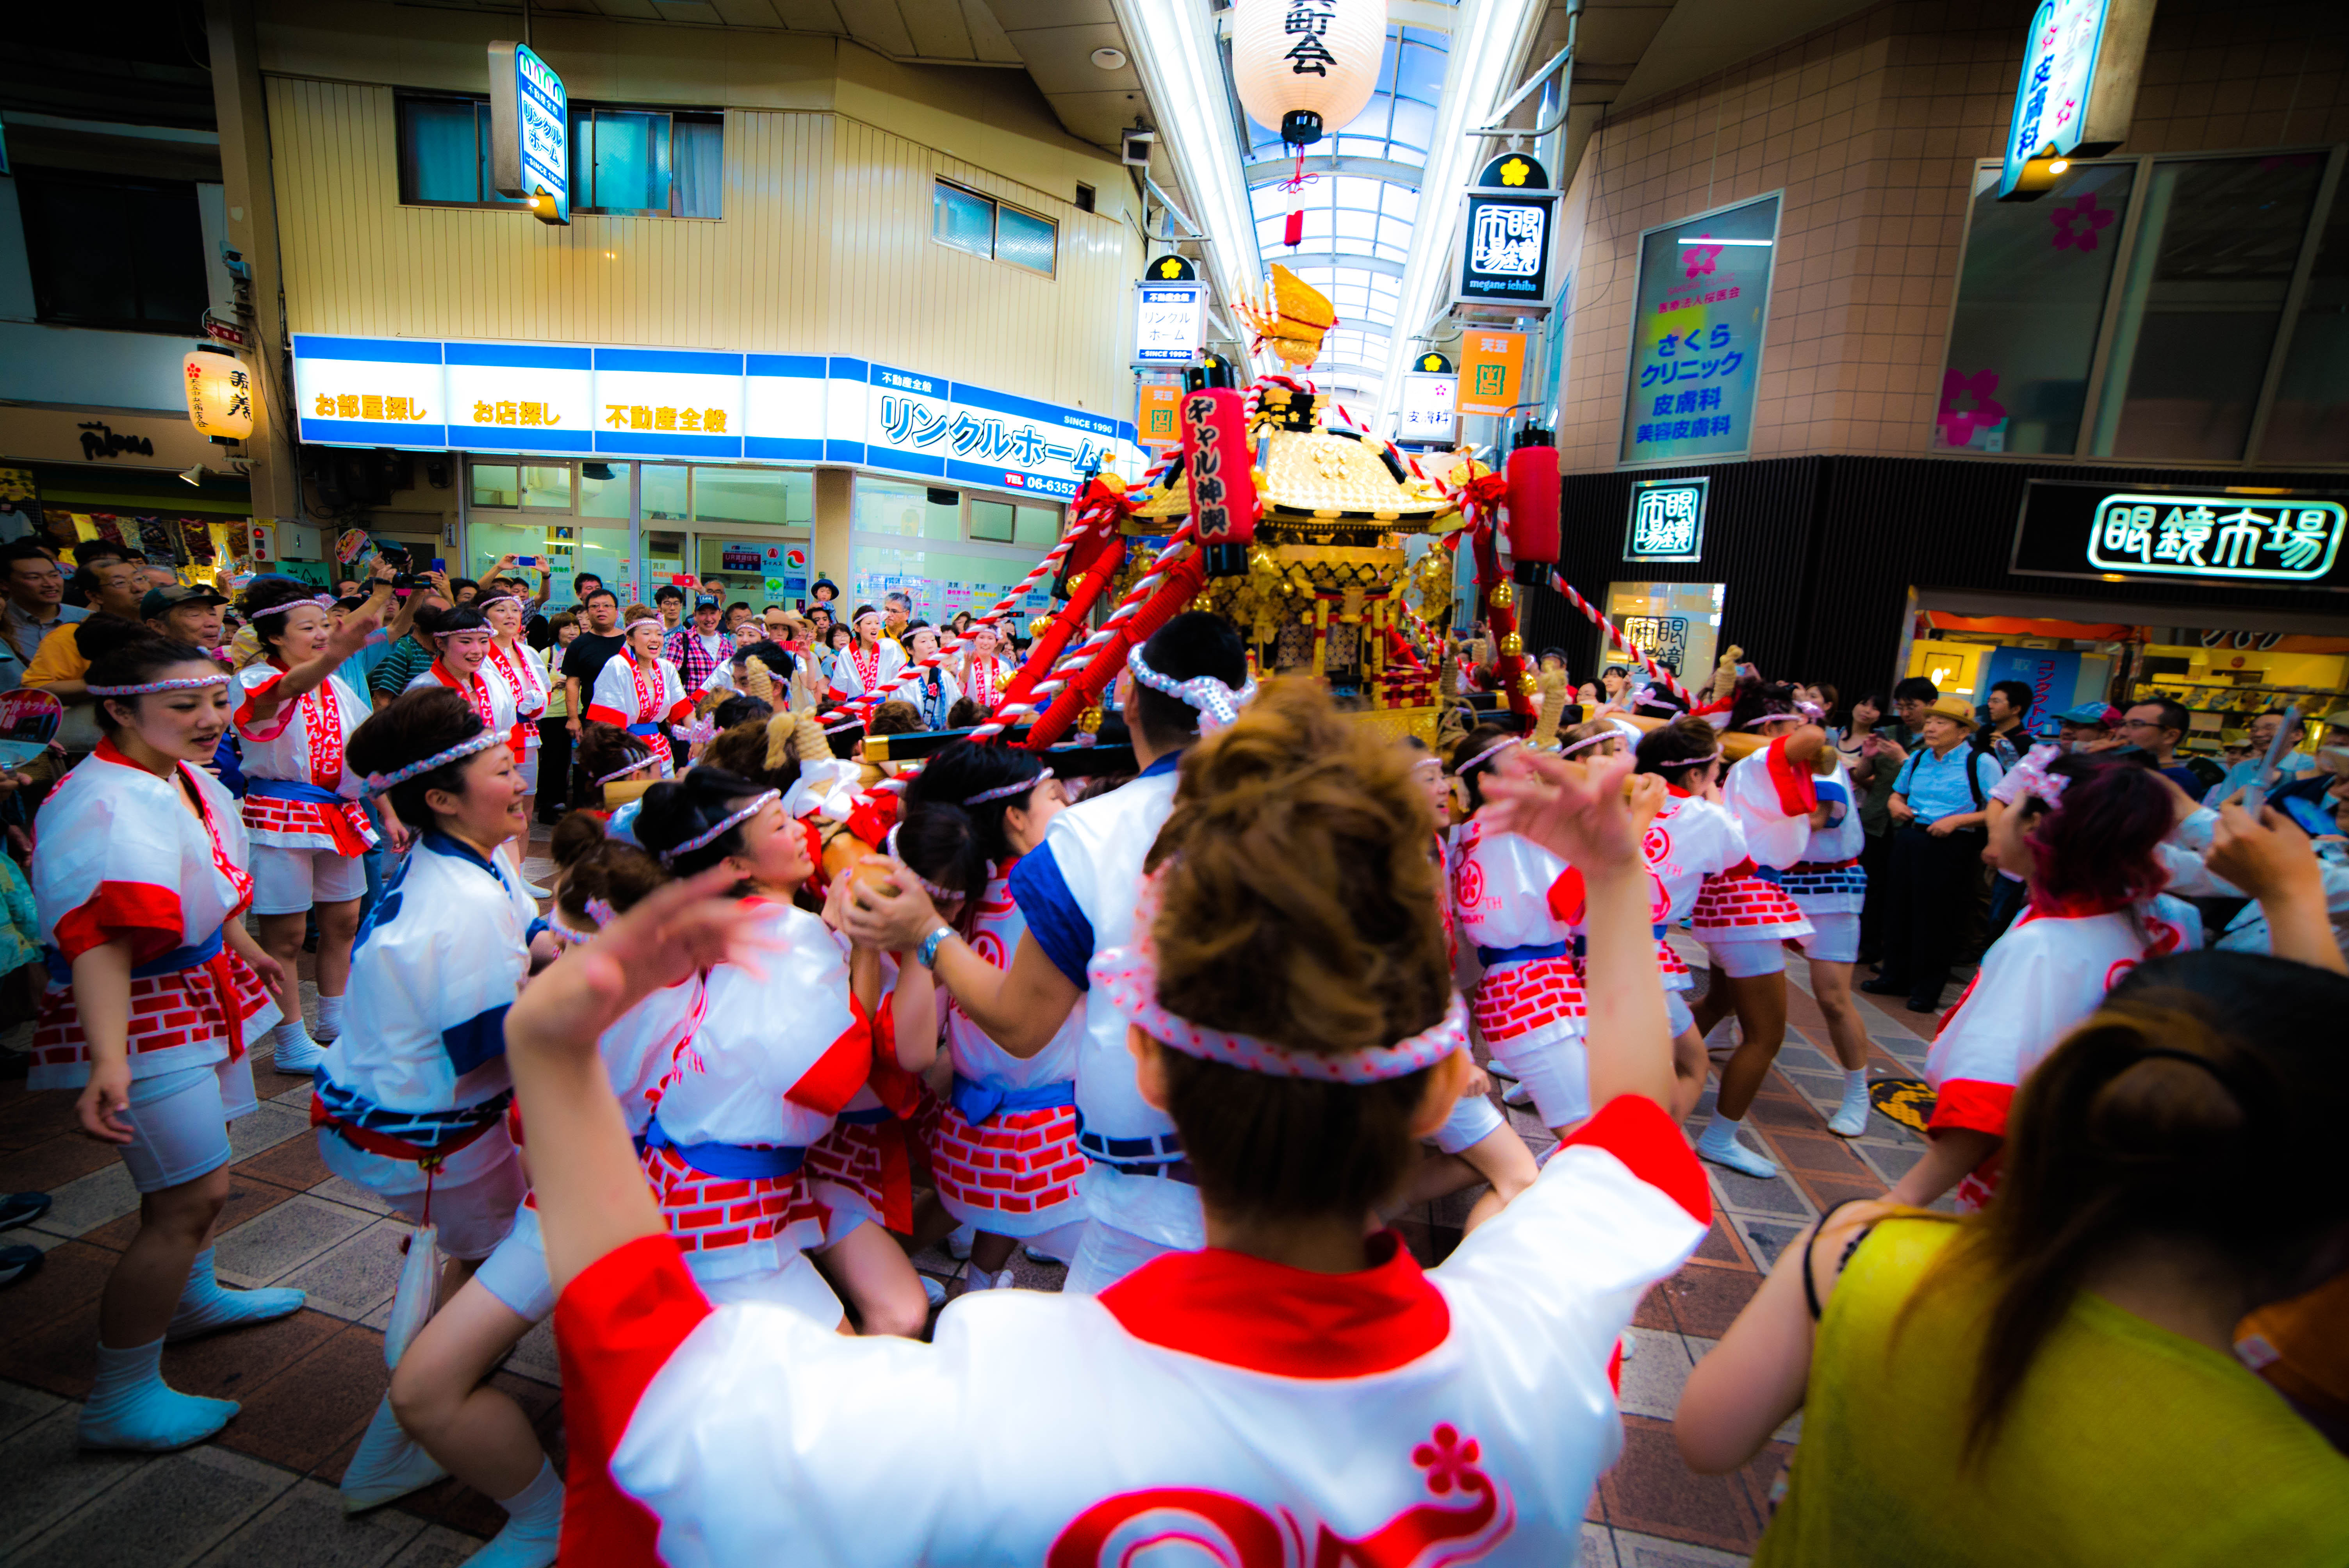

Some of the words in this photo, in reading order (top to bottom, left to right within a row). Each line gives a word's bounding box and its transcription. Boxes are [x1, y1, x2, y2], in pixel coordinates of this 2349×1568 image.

[524, 100, 563, 147] リンクル
[529, 129, 560, 167] ホーム
[1469, 280, 1506, 292] megane
[1507, 279, 1537, 292] ichiba
[1667, 280, 1701, 296] SAKURA
[1705, 272, 1735, 287] CLINIC
[1145, 312, 1191, 324] リンクル
[1149, 329, 1185, 341] ホーム
[1480, 338, 1508, 353] 天五
[1658, 323, 1732, 357] さくら
[881, 371, 932, 393] 不動産全般
[1640, 351, 1744, 388] クリニック
[315, 393, 427, 421] お部屋探し
[1153, 390, 1174, 401] 天五
[1652, 385, 1722, 417] 皮膚科
[473, 400, 561, 426] お店探し
[606, 404, 727, 434] 不動産全般
[1064, 415, 1091, 429] SINCE
[1093, 422, 1113, 434] 1990
[881, 396, 1098, 474] リンクルホーム
[1636, 414, 1731, 444] 美容皮膚科
[1006, 473, 1024, 486] TEL
[2103, 505, 2328, 570] 眼鏡市場
[321, 695, 342, 775] てんじんばし
[1484, 896, 1502, 910] TH
